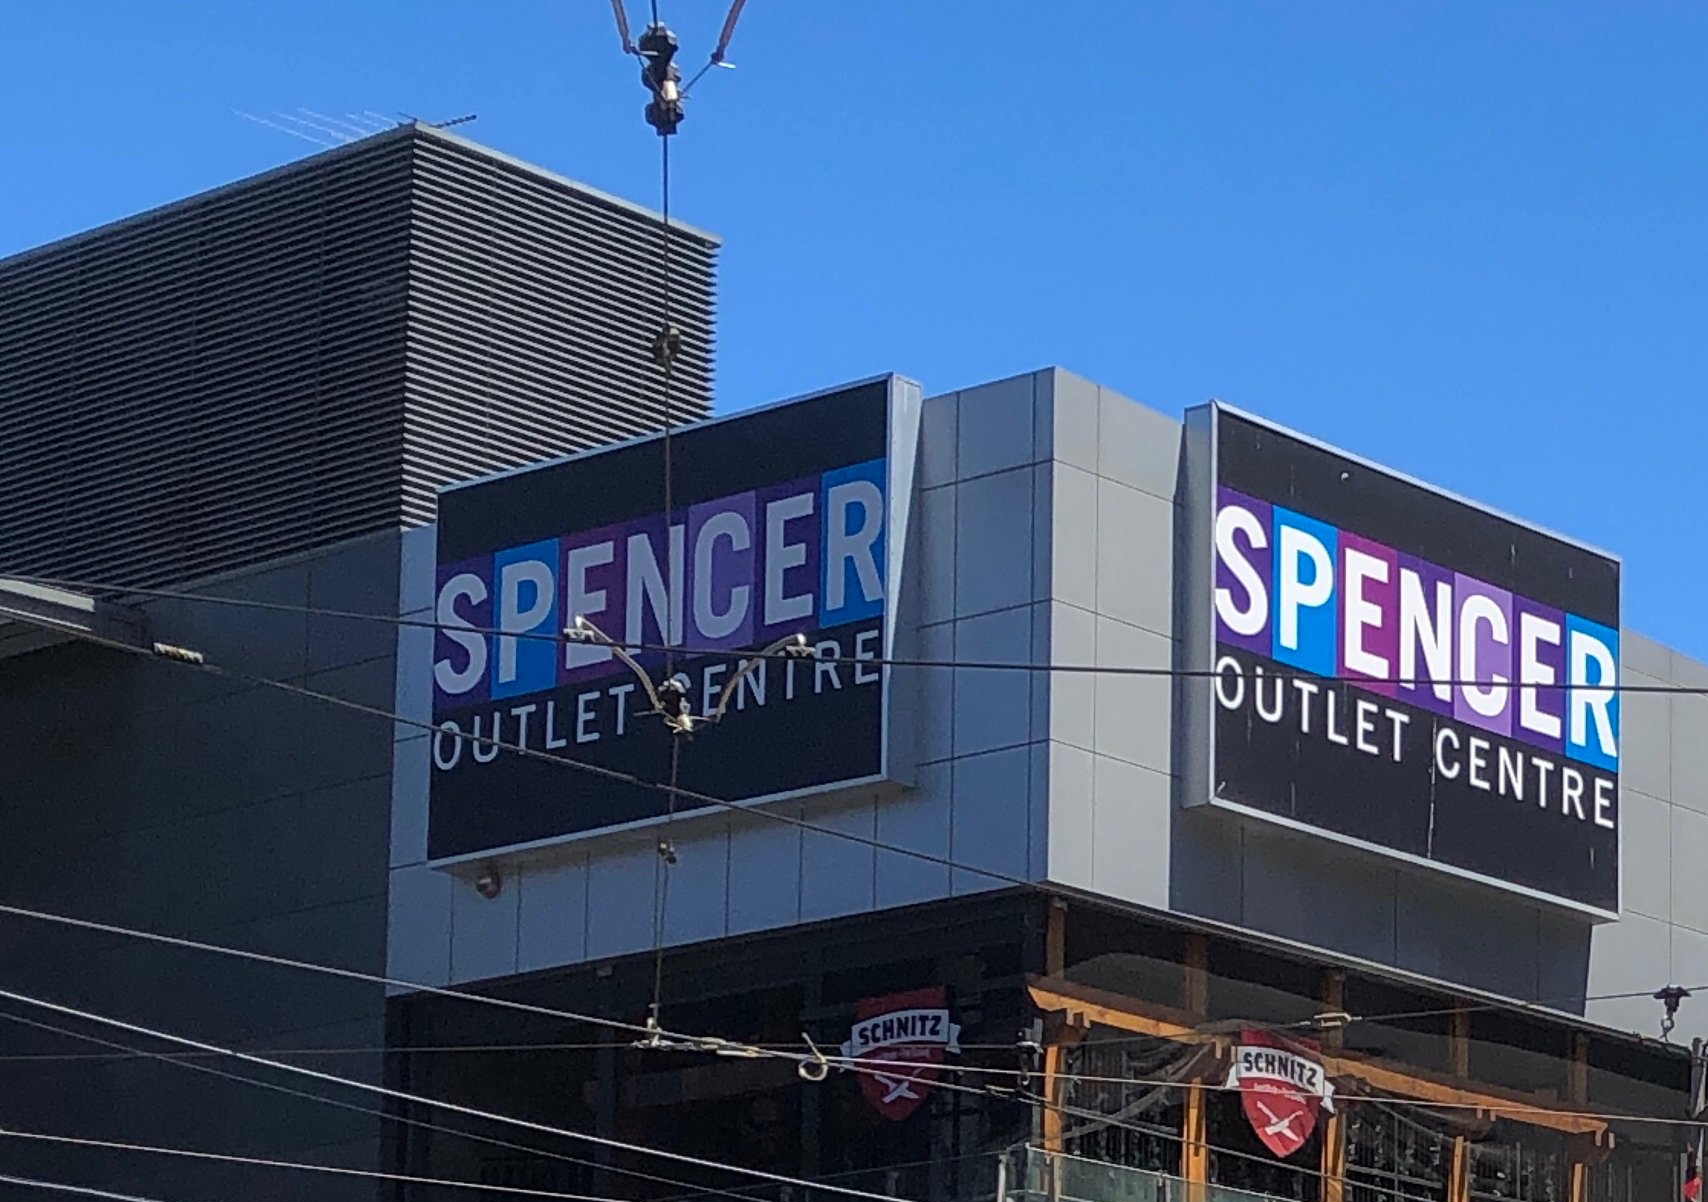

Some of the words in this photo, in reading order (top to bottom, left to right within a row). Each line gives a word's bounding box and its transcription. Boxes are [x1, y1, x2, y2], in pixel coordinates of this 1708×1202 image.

[434, 480, 885, 694] SPENCER
[1214, 505, 1618, 758] SPENCER
[433, 684, 634, 771] OUTLET
[1214, 656, 1410, 762] OUTLET
[1435, 727, 1615, 829] CENTRE
[858, 1015, 942, 1045] SCHNITZ
[1243, 1051, 1318, 1087] SCHNITZ
